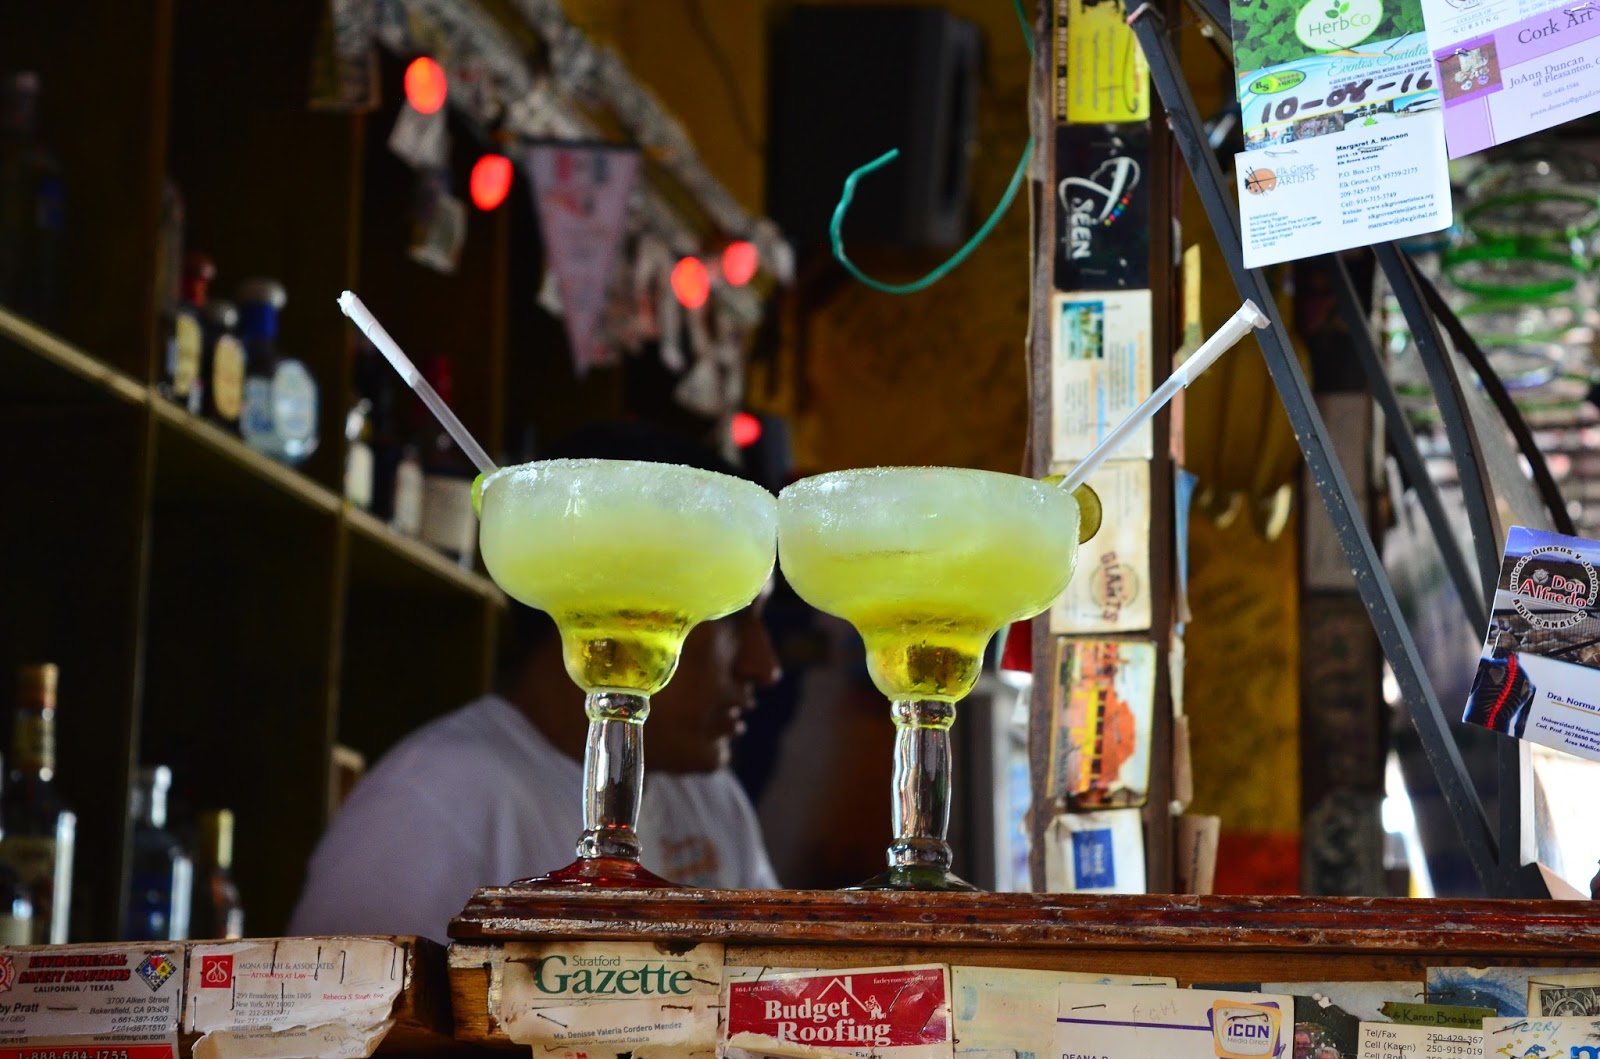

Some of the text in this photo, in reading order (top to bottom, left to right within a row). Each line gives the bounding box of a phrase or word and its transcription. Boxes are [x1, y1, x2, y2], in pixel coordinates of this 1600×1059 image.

[1308, 13, 1372, 37] HerbCo
[1453, 14, 1499, 33] NURSING
[1518, 10, 1594, 44] Cork Art
[1328, 45, 1429, 77] Eventos Sociales
[1509, 56, 1584, 89] JoAnn Duncan
[1533, 78, 1542, 87] of
[1336, 141, 1369, 151] Margaret
[1380, 132, 1409, 142] Munson
[1290, 164, 1314, 174] Grove
[1366, 165, 1380, 173] 2175
[1277, 172, 1315, 187] ARTISTS
[1532, 546, 1573, 556] Quesos
[1582, 561, 1598, 605] Jabones
[1552, 575, 1586, 594] Don
[1517, 579, 1586, 608] Alfredo
[1512, 598, 1587, 628] ARTESANALES
[1547, 692, 1564, 702] Dra.
[1566, 697, 1595, 710] Norma
[573, 955, 620, 967] Stratford
[18, 970, 65, 984] SAFETY
[65, 968, 131, 983] SOLUTIONS
[534, 955, 692, 995] Gazette
[33, 985, 80, 993] CALIFORNIA
[90, 983, 114, 992] TEXAS
[13, 1003, 39, 1013] Pratt
[107, 997, 125, 1005] 3700
[148, 996, 170, 1004] Street
[89, 1007, 131, 1015] Bakersfield,
[764, 998, 850, 1023] Budget
[1403, 1009, 1434, 1022] Karen
[1436, 1011, 1484, 1024] Breakwe
[554, 1022, 682, 1040] Ma. Denisse Valeria Cordero Mendez
[777, 1018, 892, 1046] Roofing
[1365, 1029, 1397, 1038] Tel/Fax
[1383, 1042, 1416, 1052] (Karen)
